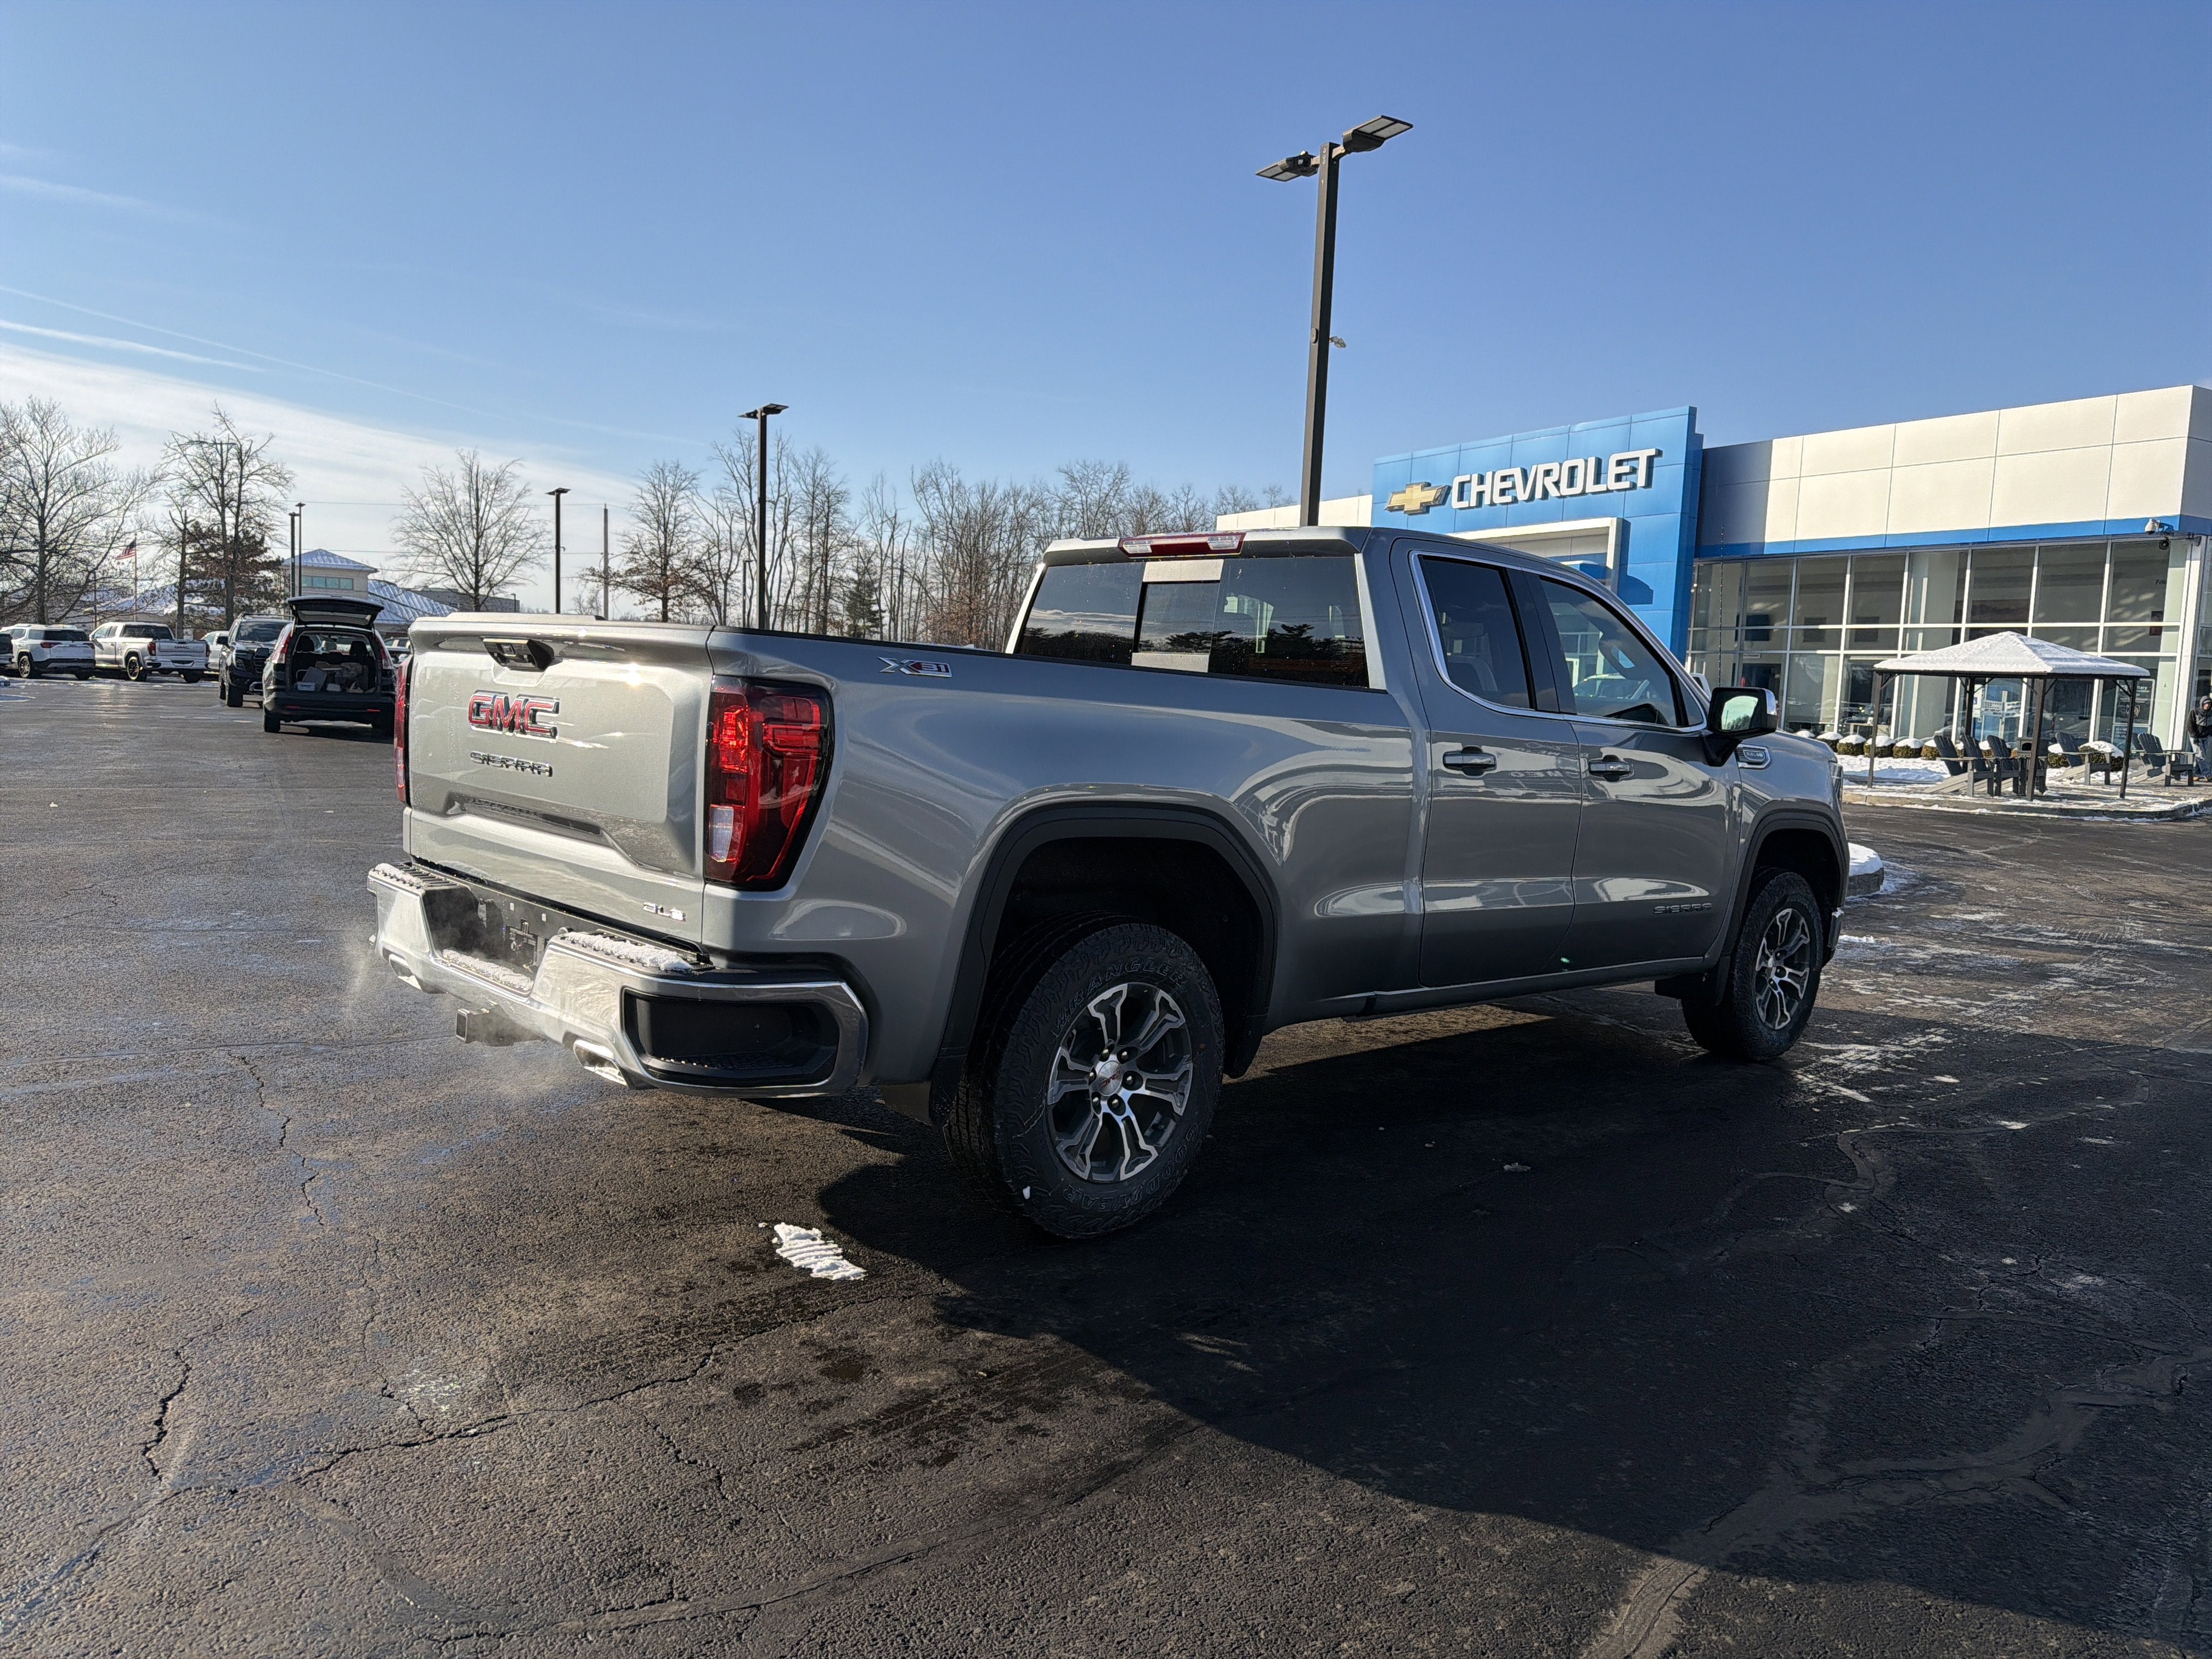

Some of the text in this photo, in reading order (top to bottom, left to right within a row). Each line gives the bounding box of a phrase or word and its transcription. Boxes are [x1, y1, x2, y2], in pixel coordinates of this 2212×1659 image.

[1451, 448, 1661, 510] CHEVROLET
[878, 657, 952, 678] X31
[469, 690, 560, 741] GMC
[470, 751, 552, 777] SIERRA
[1653, 902, 1712, 914] SIERRA
[1051, 957, 1187, 1037] WRANGLER
[1100, 1069, 1121, 1088] GMC
[1062, 1123, 1199, 1212] GOODYEAR
